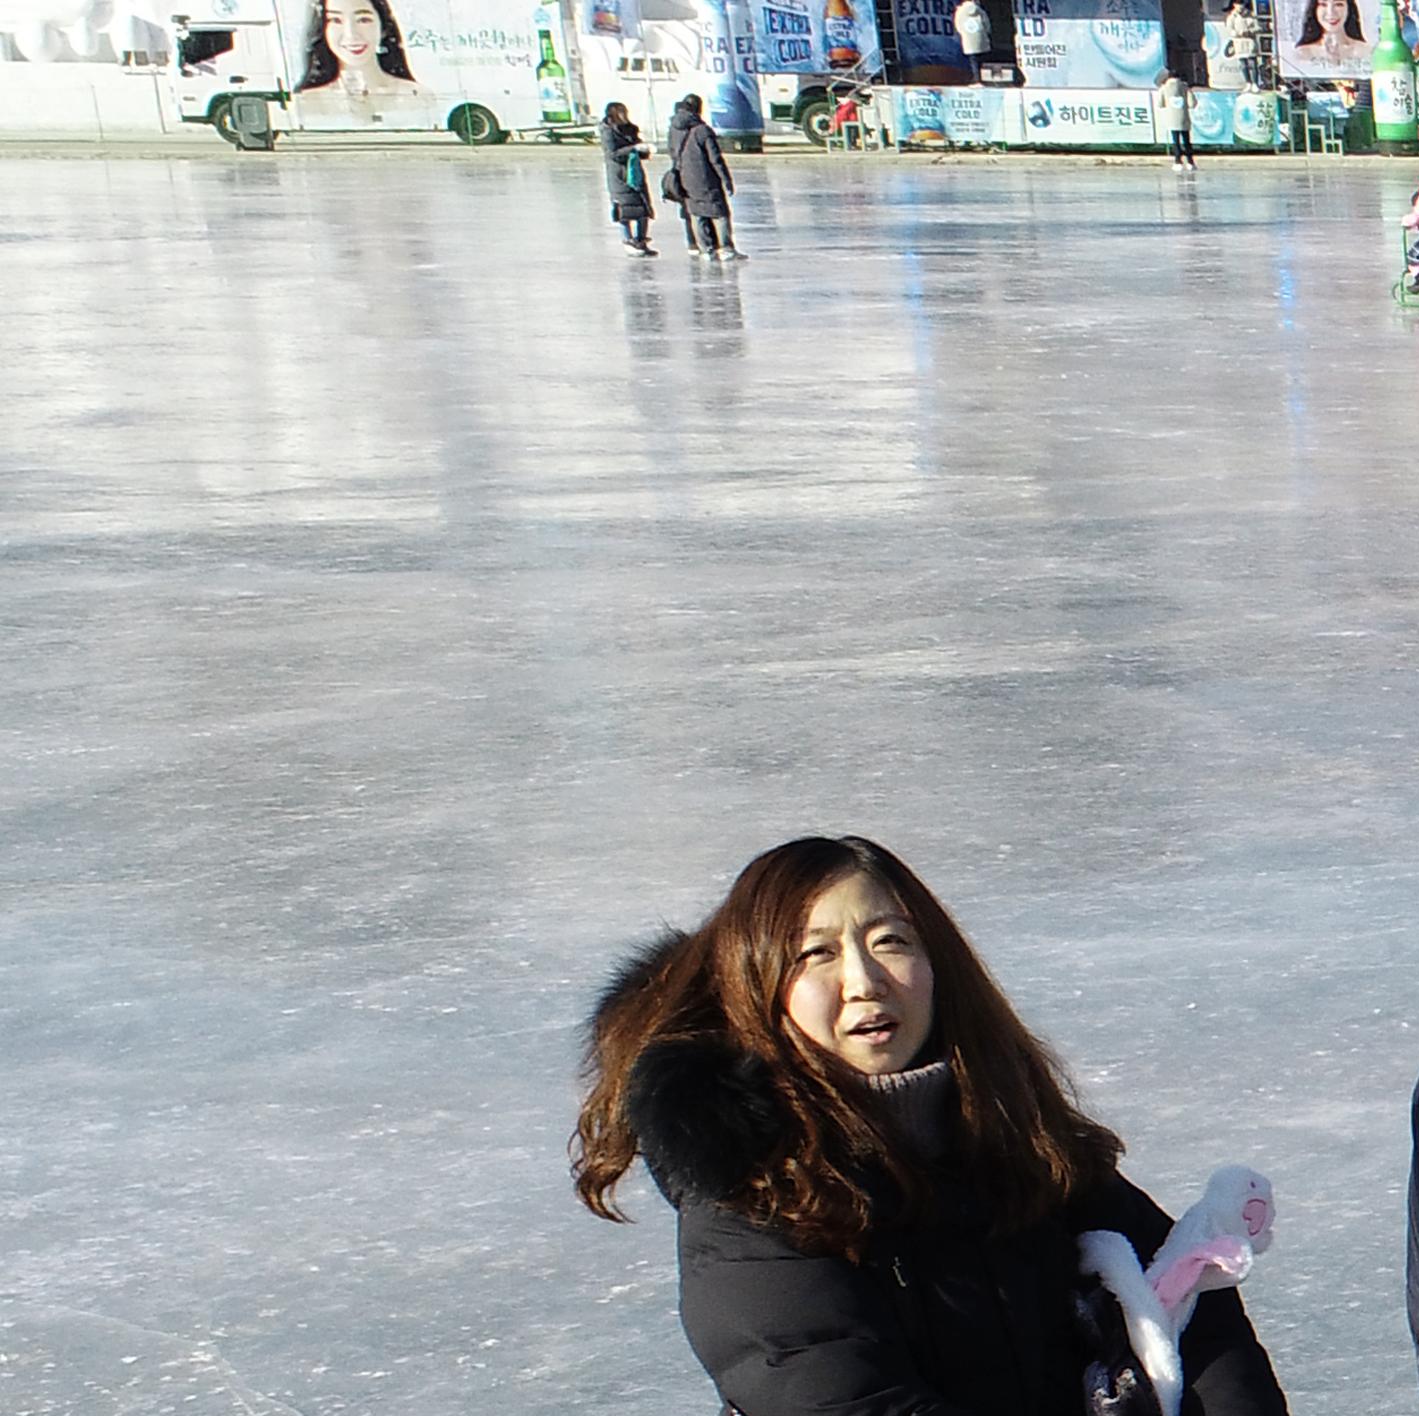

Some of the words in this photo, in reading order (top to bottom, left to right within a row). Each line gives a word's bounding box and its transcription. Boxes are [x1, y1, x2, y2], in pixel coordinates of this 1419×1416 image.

[764, 7, 812, 35] EXTRA
[776, 38, 812, 63] COLD
[1058, 105, 1150, 126] 하이트진로
